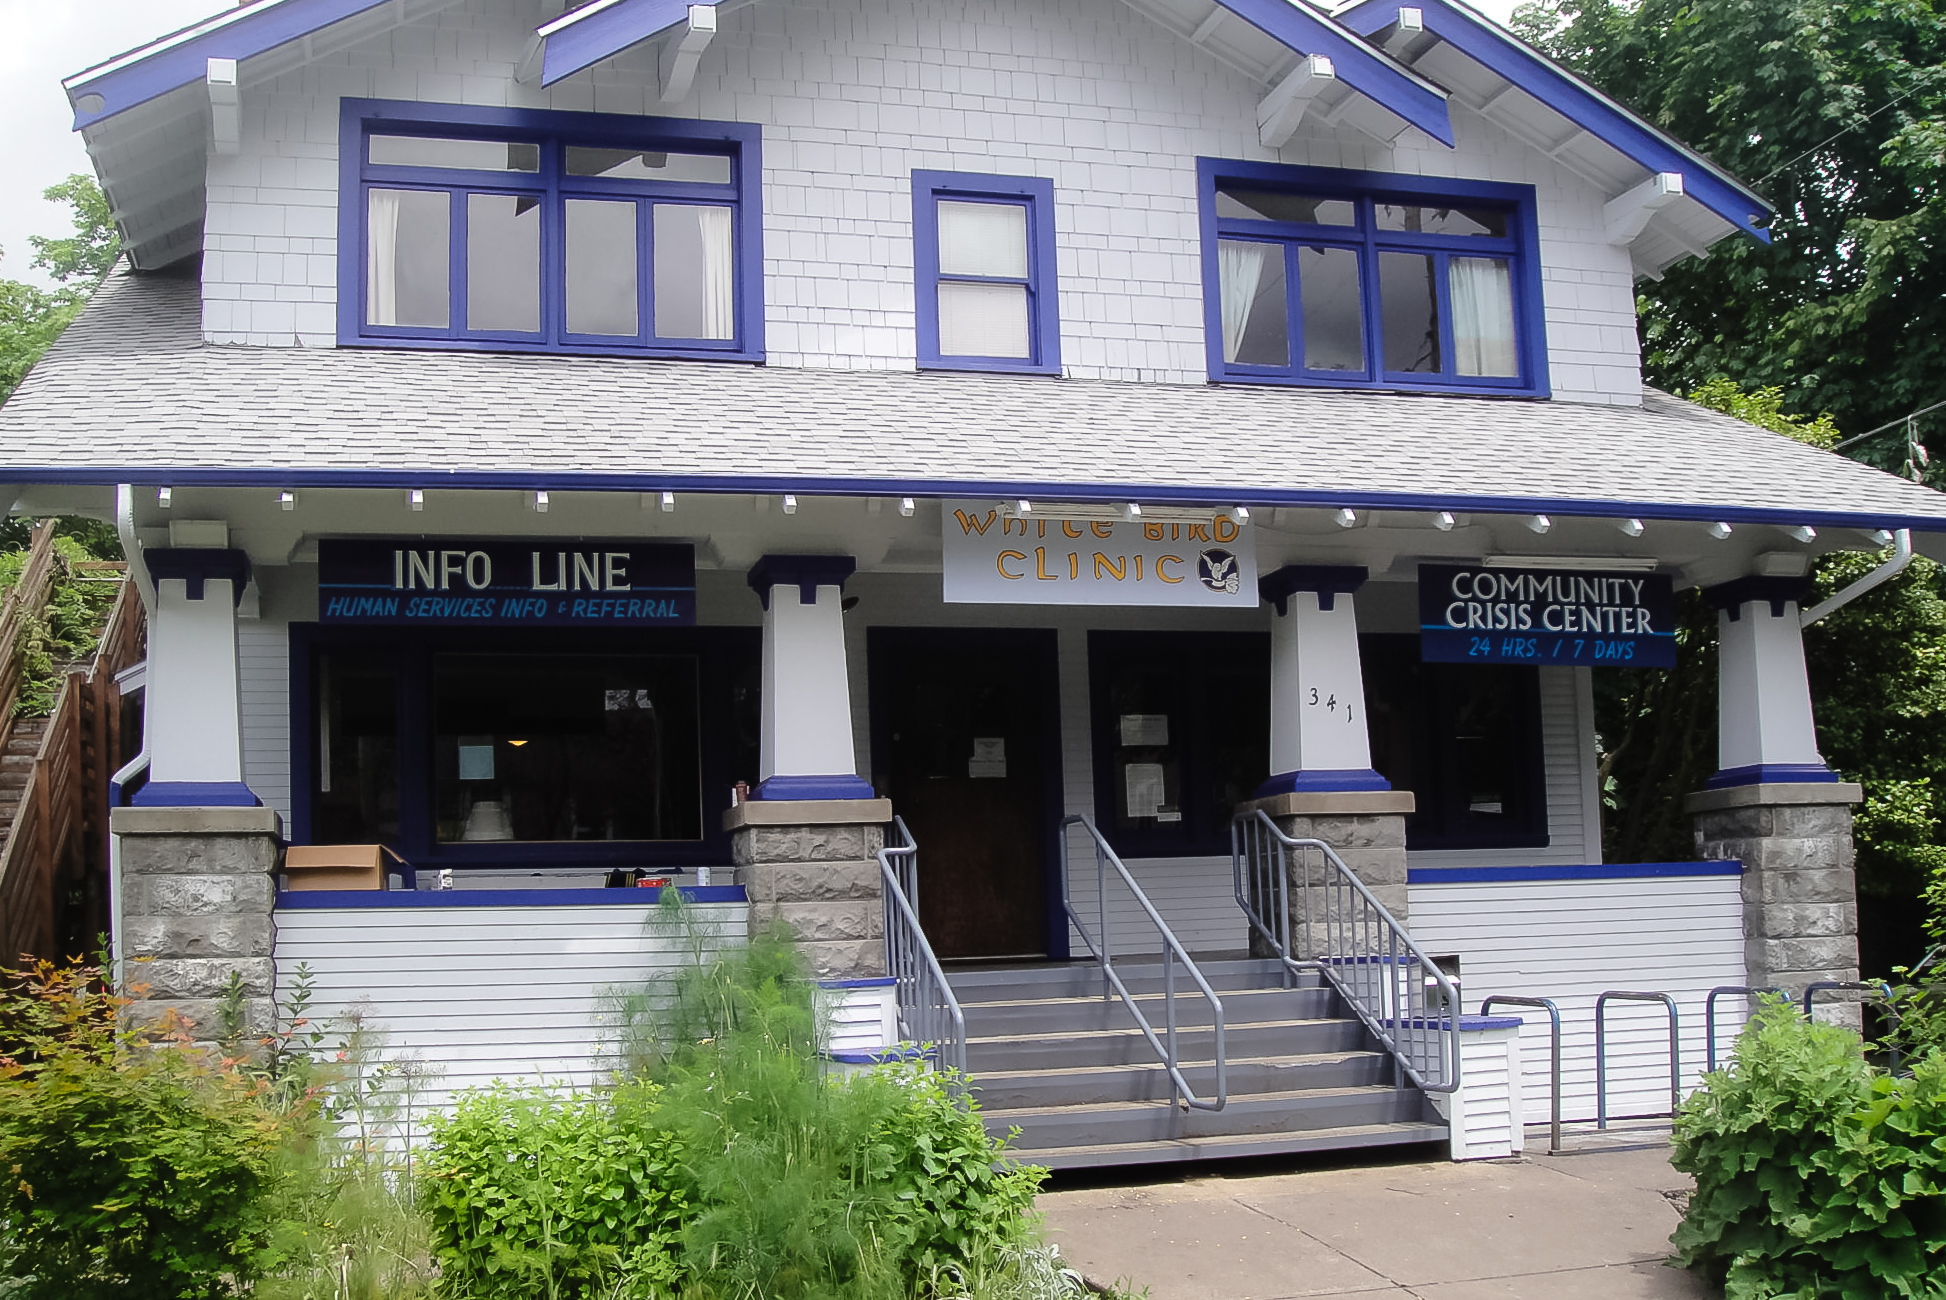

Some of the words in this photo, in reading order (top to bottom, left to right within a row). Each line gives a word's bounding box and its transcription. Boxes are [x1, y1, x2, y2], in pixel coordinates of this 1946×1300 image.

[1143, 514, 1240, 543] BIRD
[393, 550, 492, 590] INFO
[531, 551, 631, 591] LINE
[996, 546, 1185, 584] CLINIC
[1452, 572, 1644, 605] COMMUNITY
[327, 597, 398, 617] HUMAN
[405, 598, 496, 618] SERVICES
[500, 599, 547, 618] INFO
[571, 599, 680, 618] REFERRAL
[1446, 601, 1532, 631] CRISIS
[1542, 605, 1654, 634] CENTER
[1469, 637, 1491, 656] 24
[1501, 638, 1542, 658] HRS.
[1574, 639, 1586, 658] 7
[1594, 640, 1635, 660] DAYS
[1308, 687, 1353, 724] 341
